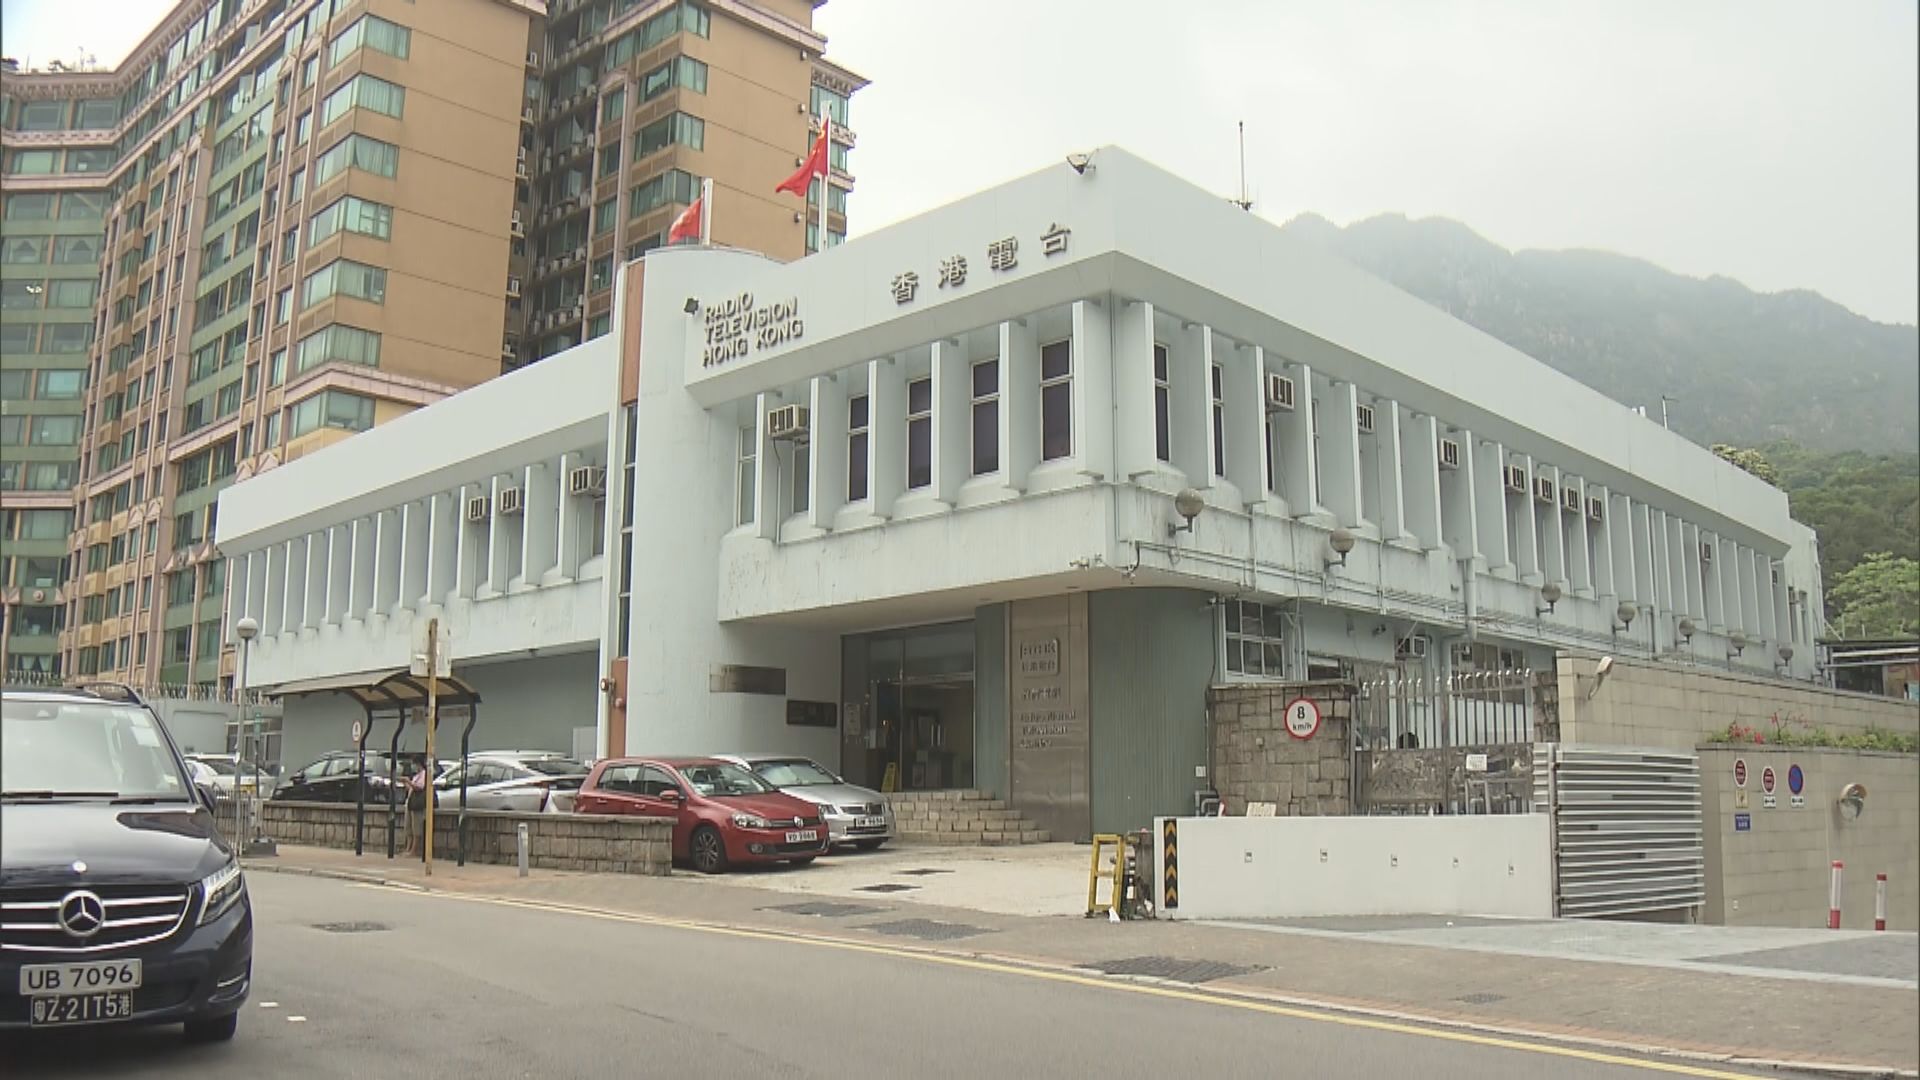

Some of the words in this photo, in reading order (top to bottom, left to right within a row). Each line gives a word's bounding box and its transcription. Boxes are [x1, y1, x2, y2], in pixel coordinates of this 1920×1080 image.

[891, 222, 1071, 304] 香港電台
[705, 293, 754, 325] RADIO
[705, 296, 798, 345] TELEVISION
[703, 338, 748, 368] HONG
[756, 320, 803, 351] KONG
[1292, 722, 1312, 731] km/h
[1297, 706, 1305, 719] 8
[28, 969, 60, 989] UB
[69, 964, 133, 988] 7096
